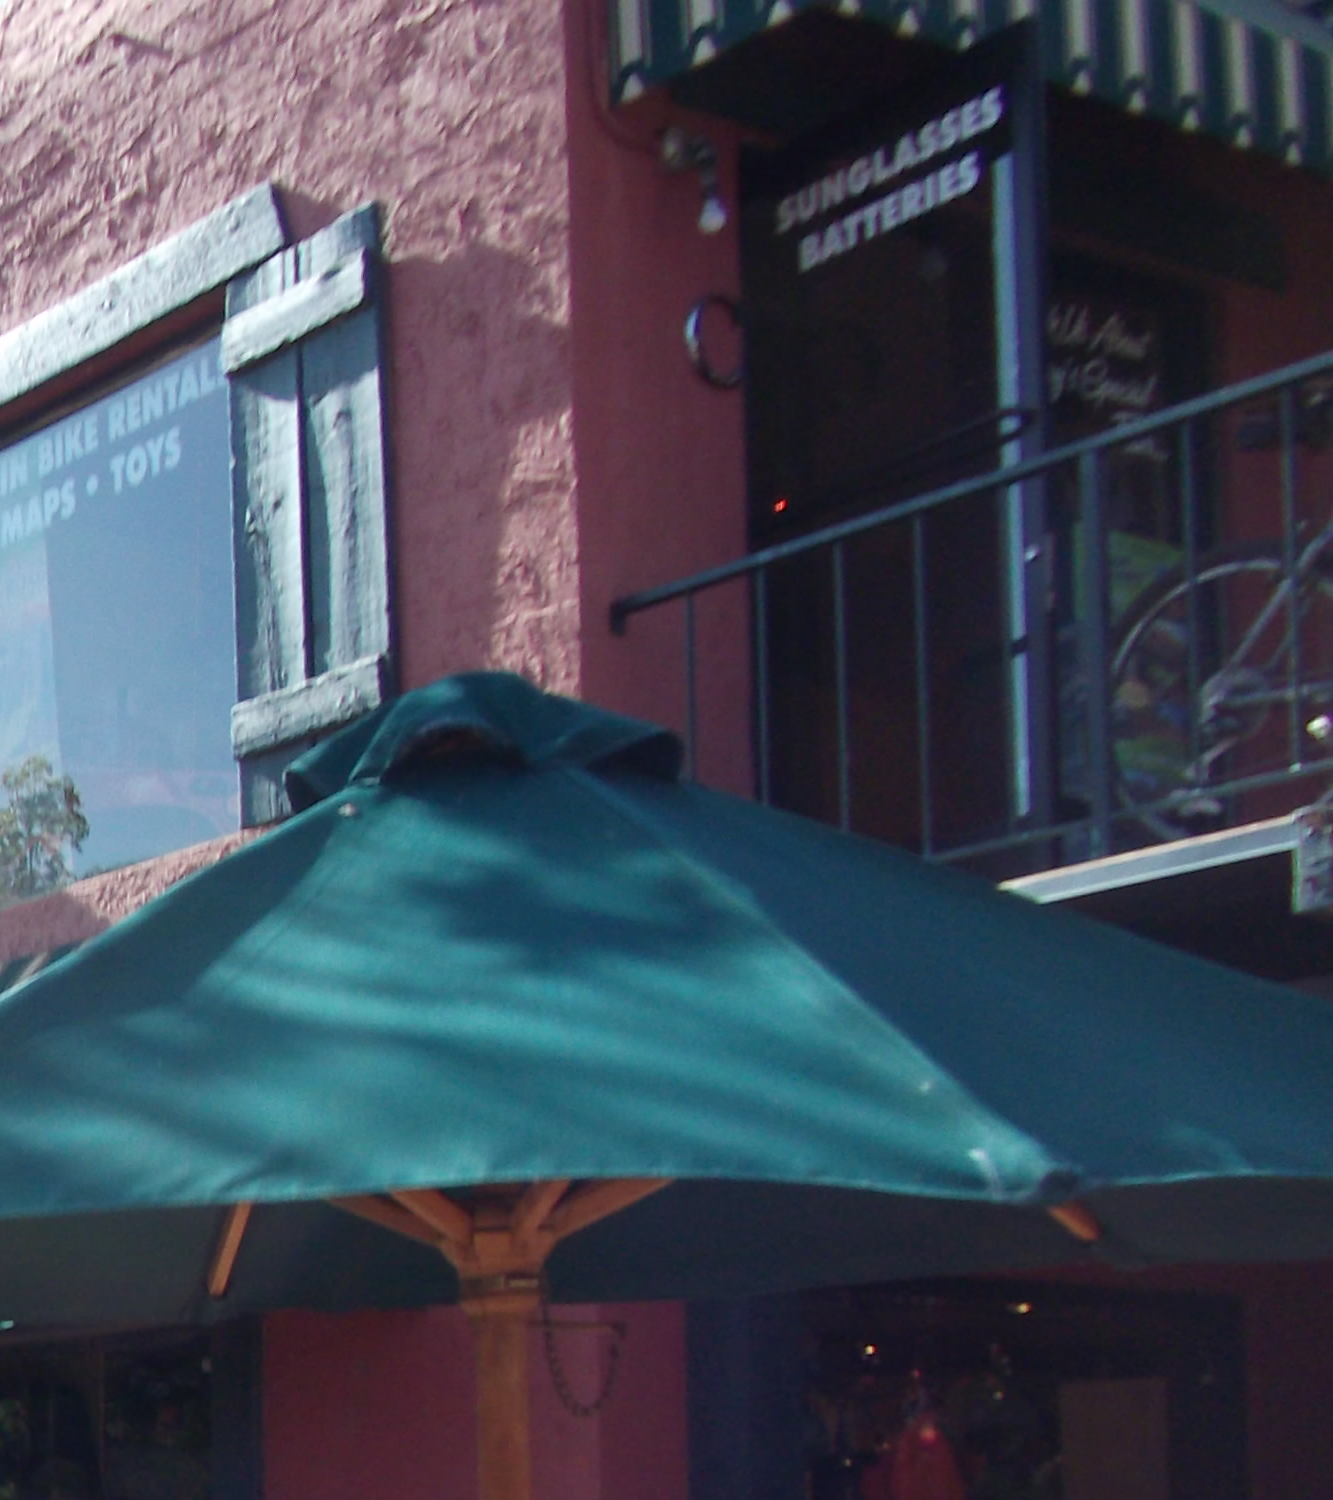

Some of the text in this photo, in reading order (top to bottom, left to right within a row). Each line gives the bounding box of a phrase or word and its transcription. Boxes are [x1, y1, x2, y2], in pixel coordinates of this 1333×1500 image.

[775, 85, 1003, 235] SUNGLASSES
[798, 151, 980, 275] BATTERIES
[1, 476, 76, 547] MAPS
[109, 426, 181, 494] TOYS
[38, 414, 99, 479] BIKE
